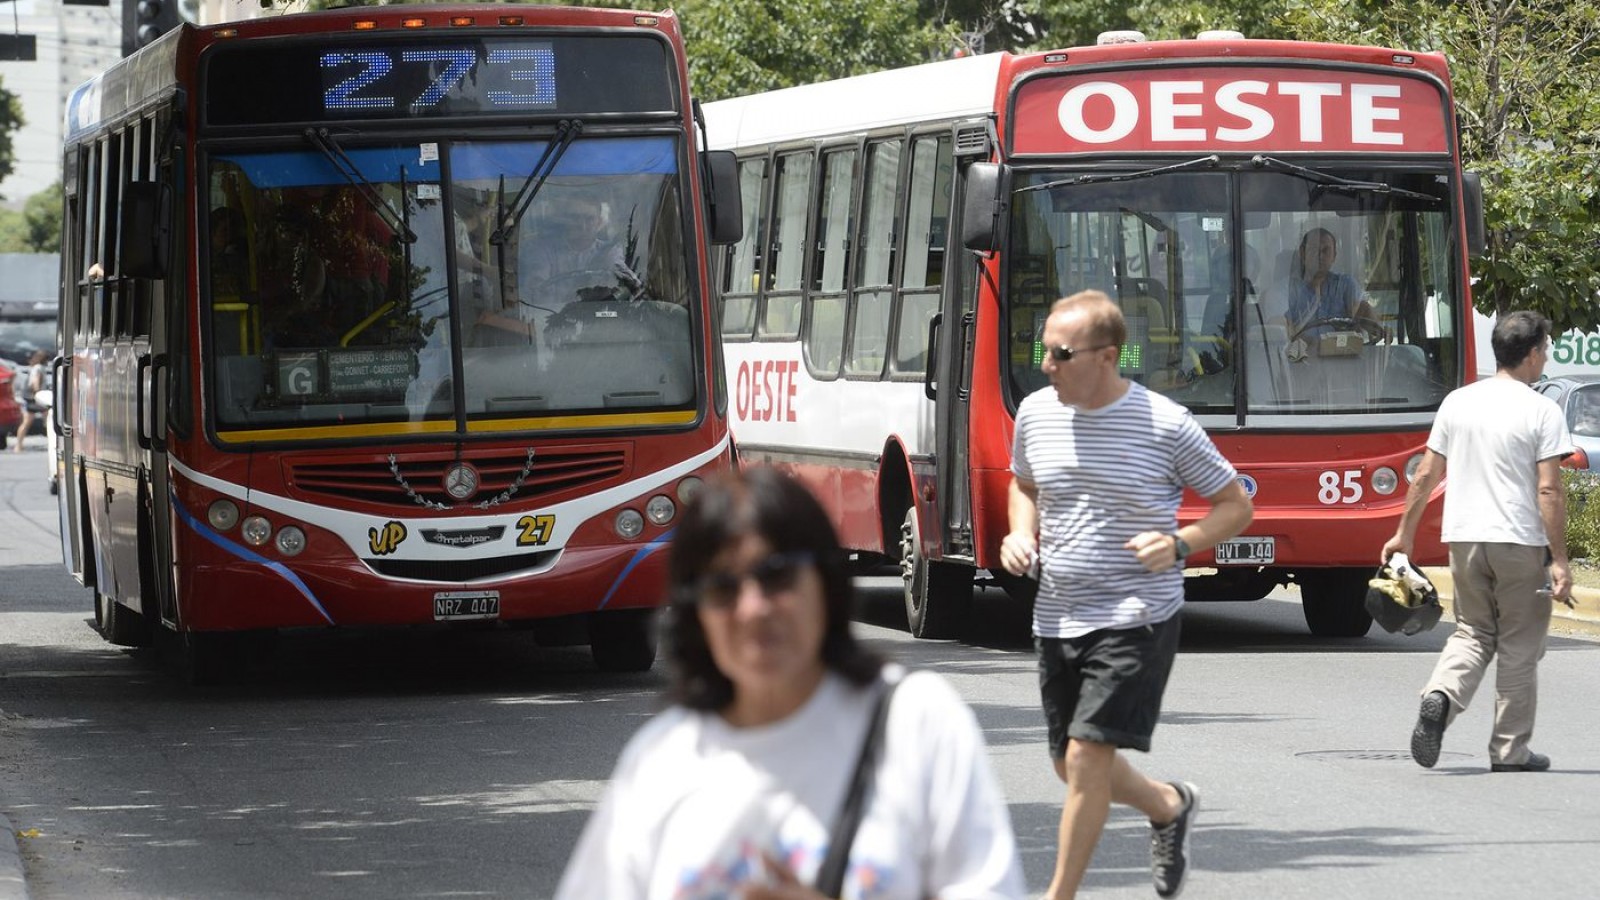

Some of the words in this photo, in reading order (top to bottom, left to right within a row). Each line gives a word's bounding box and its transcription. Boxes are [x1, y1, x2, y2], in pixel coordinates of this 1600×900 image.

[320, 49, 556, 109] 273
[1057, 80, 1404, 145] OESTE
[330, 352, 374, 364] CEMENTERIO
[381, 351, 408, 361] CENTRO
[1552, 334, 1600, 366] 518
[288, 367, 313, 395] G
[736, 359, 799, 422] OESTE
[1318, 470, 1363, 504] 85
[443, 533, 490, 545] metalpar
[516, 514, 555, 547] 27
[1217, 543, 1241, 559] HVT
[1248, 543, 1272, 559] 144
[436, 599, 462, 615] NRZ
[471, 598, 497, 614] 447
